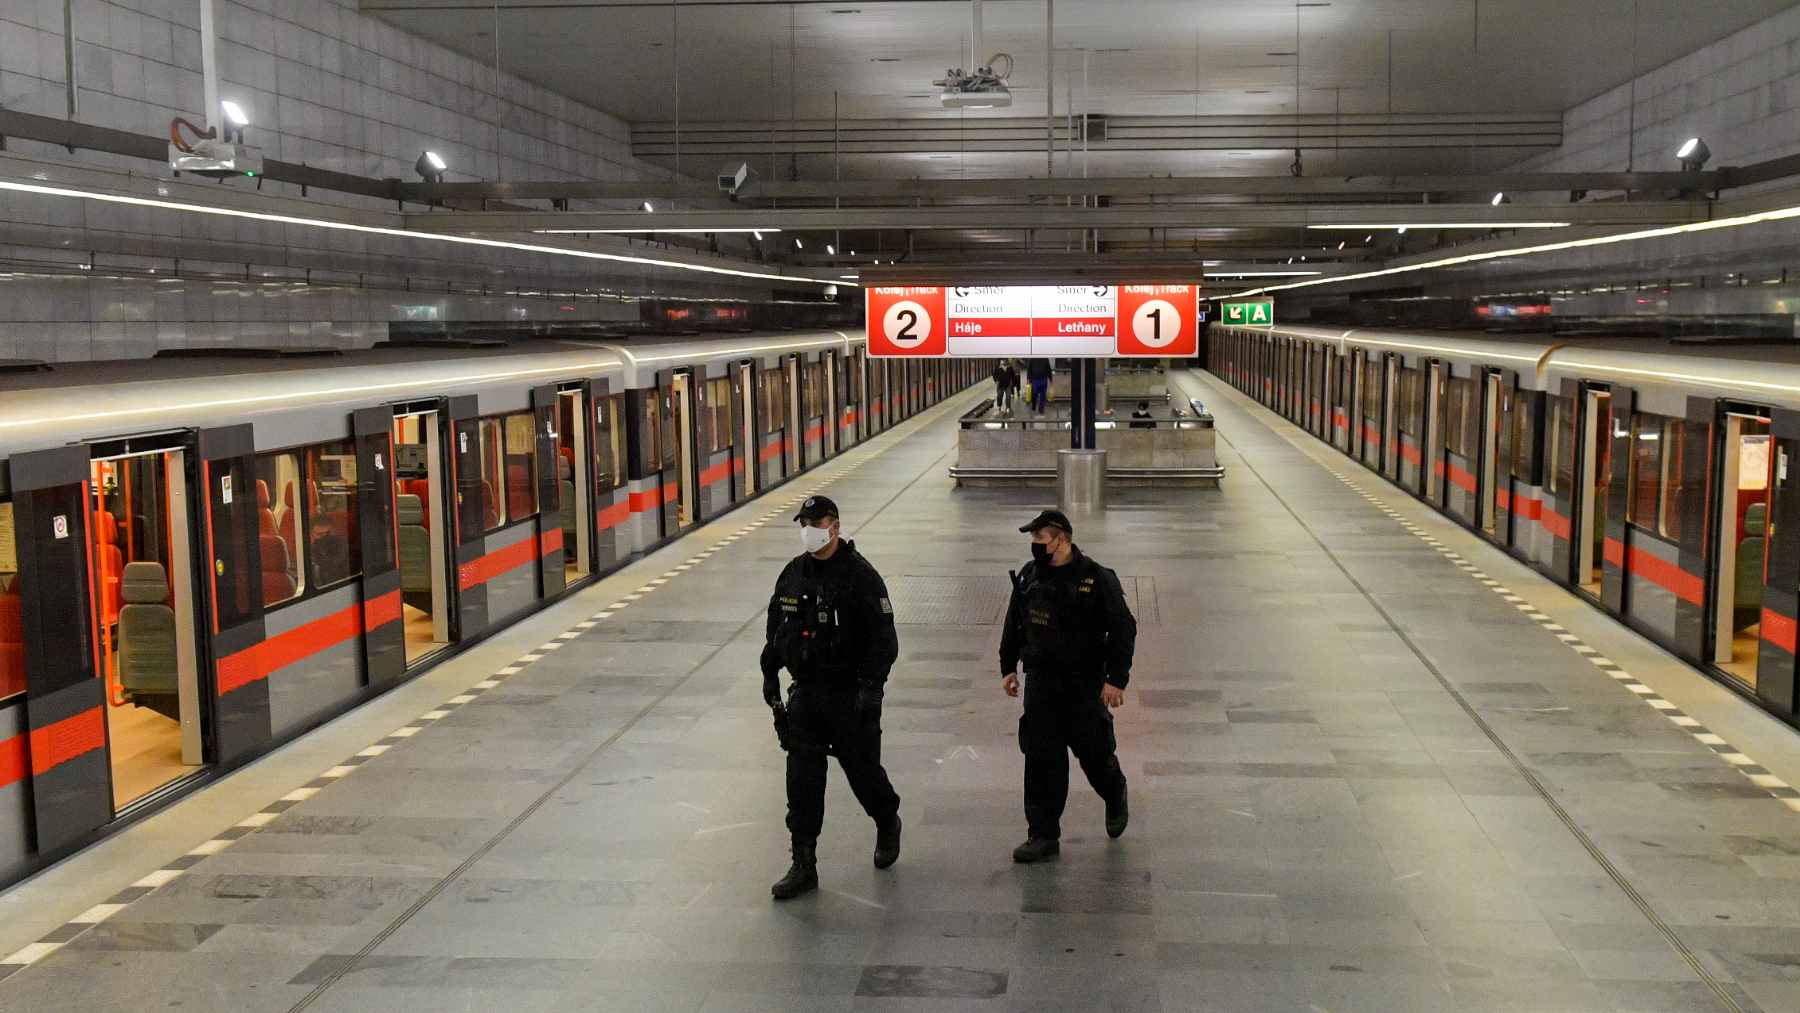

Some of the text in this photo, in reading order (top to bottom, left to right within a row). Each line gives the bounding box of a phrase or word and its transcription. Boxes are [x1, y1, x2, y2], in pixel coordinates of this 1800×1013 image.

[955, 303, 1003, 313] Direction
[1058, 303, 1107, 313] Direction
[1252, 304, 1267, 321] A
[896, 310, 918, 340] 2
[955, 321, 982, 335] Háje
[1058, 321, 1106, 335] Letňany
[1146, 308, 1161, 340] 1
